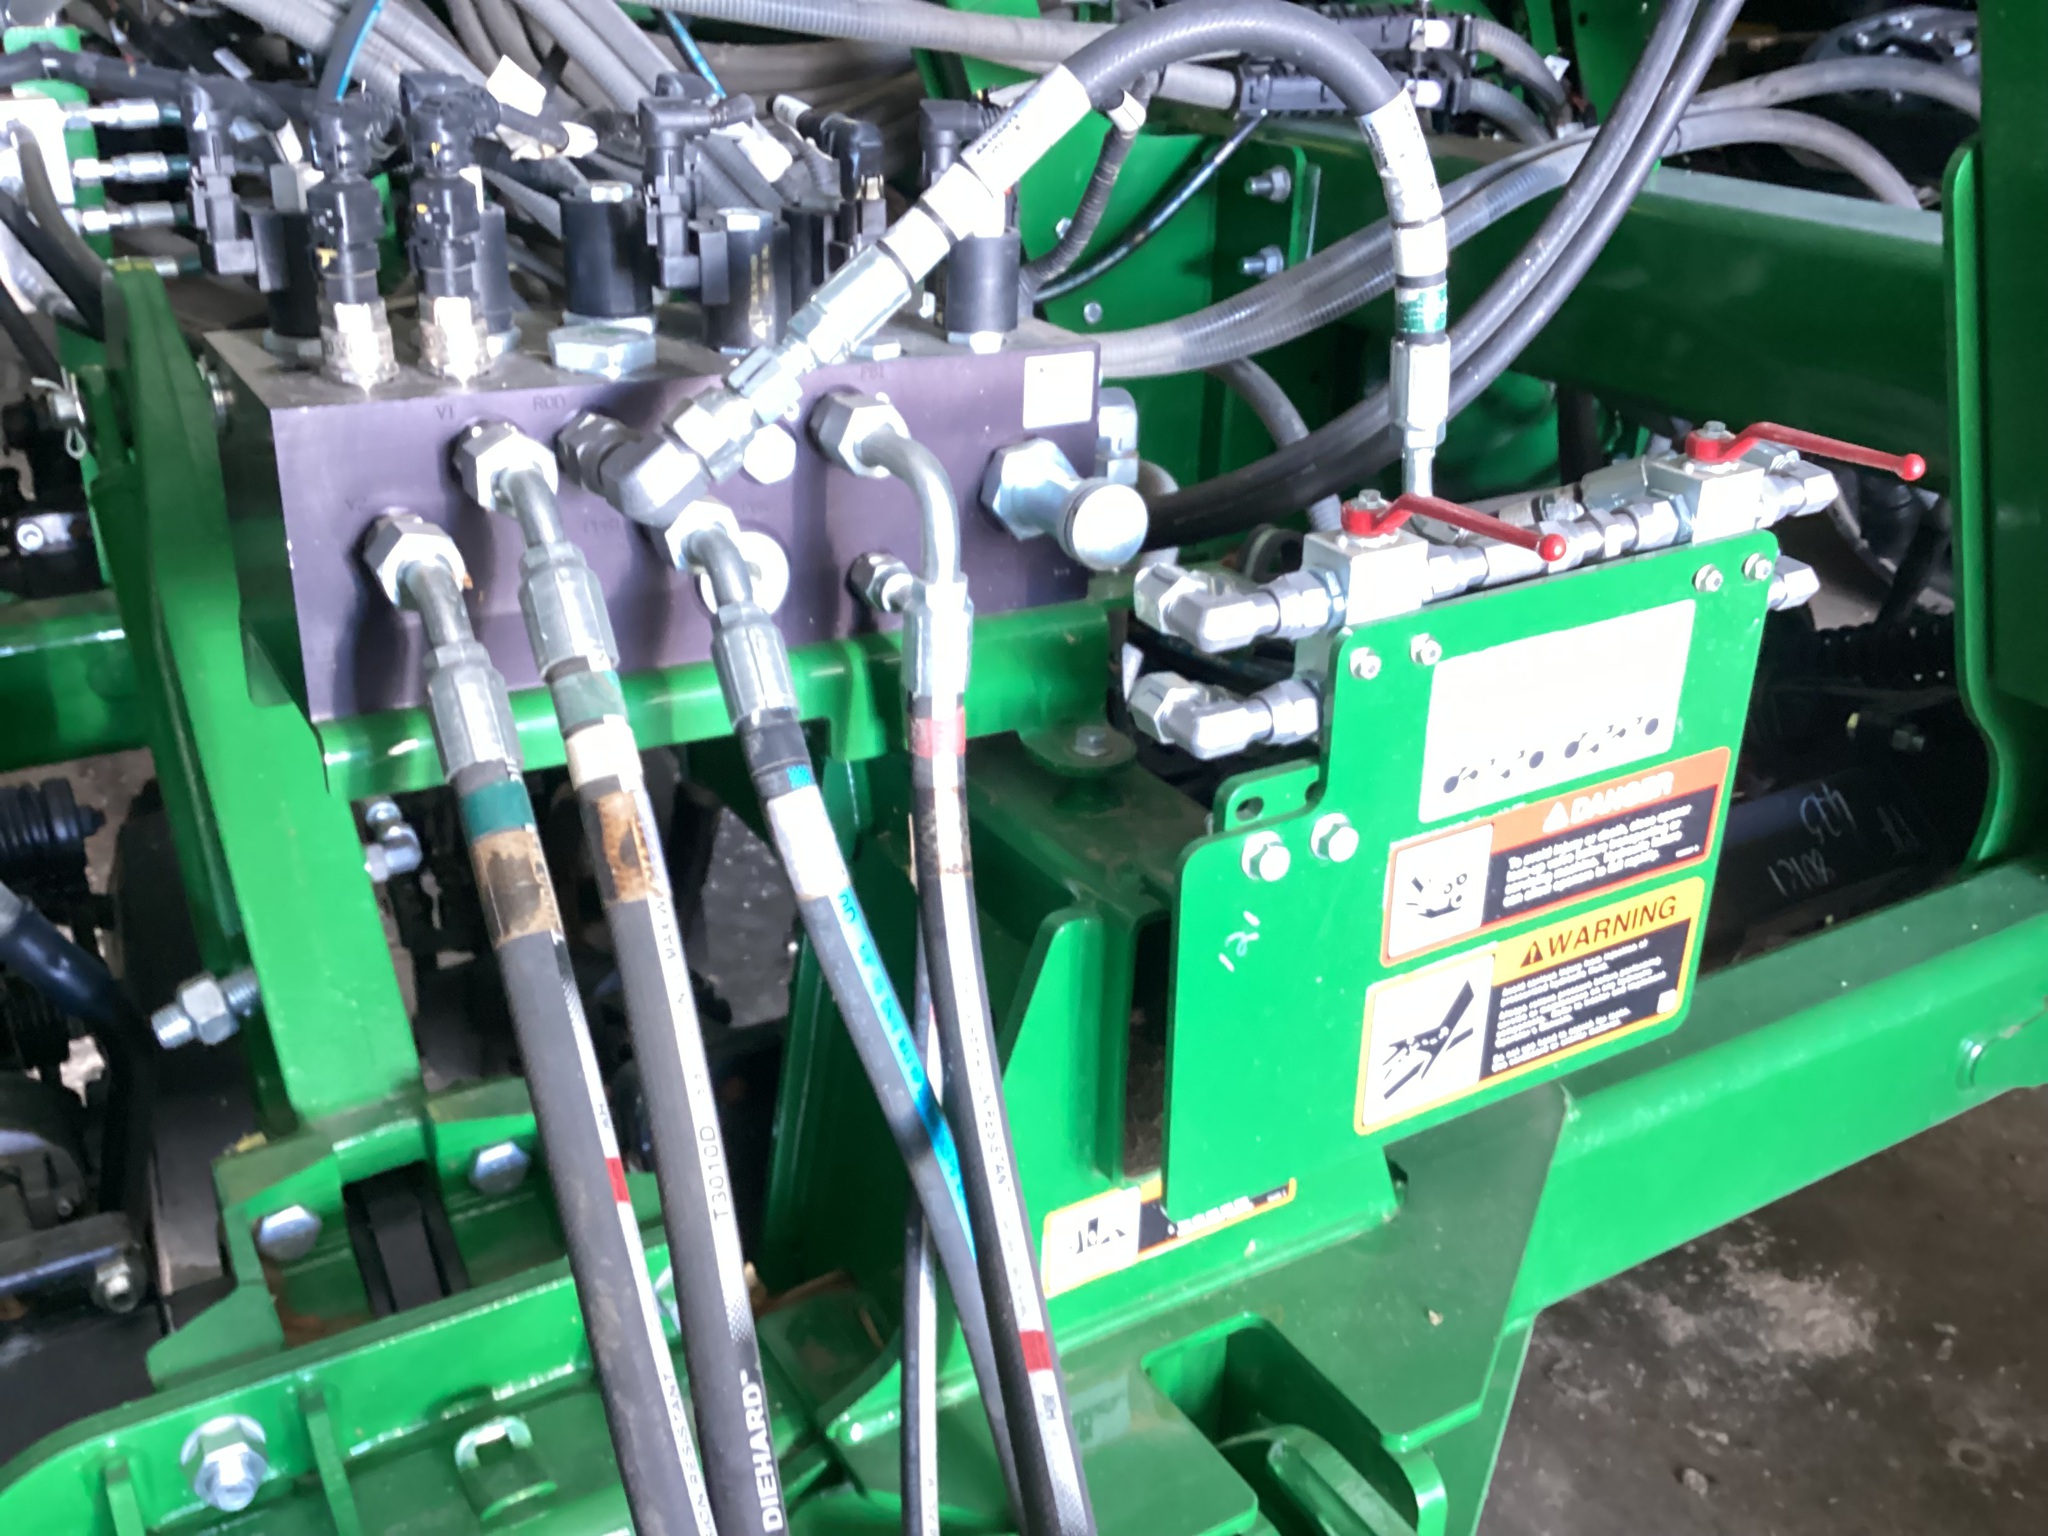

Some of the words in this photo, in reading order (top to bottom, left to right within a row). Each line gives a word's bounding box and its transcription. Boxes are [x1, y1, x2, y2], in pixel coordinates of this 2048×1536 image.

[1570, 771, 1674, 824] DANGER
[1549, 896, 1676, 957] WARNING
[742, 1382, 783, 1532] DIEHARD
